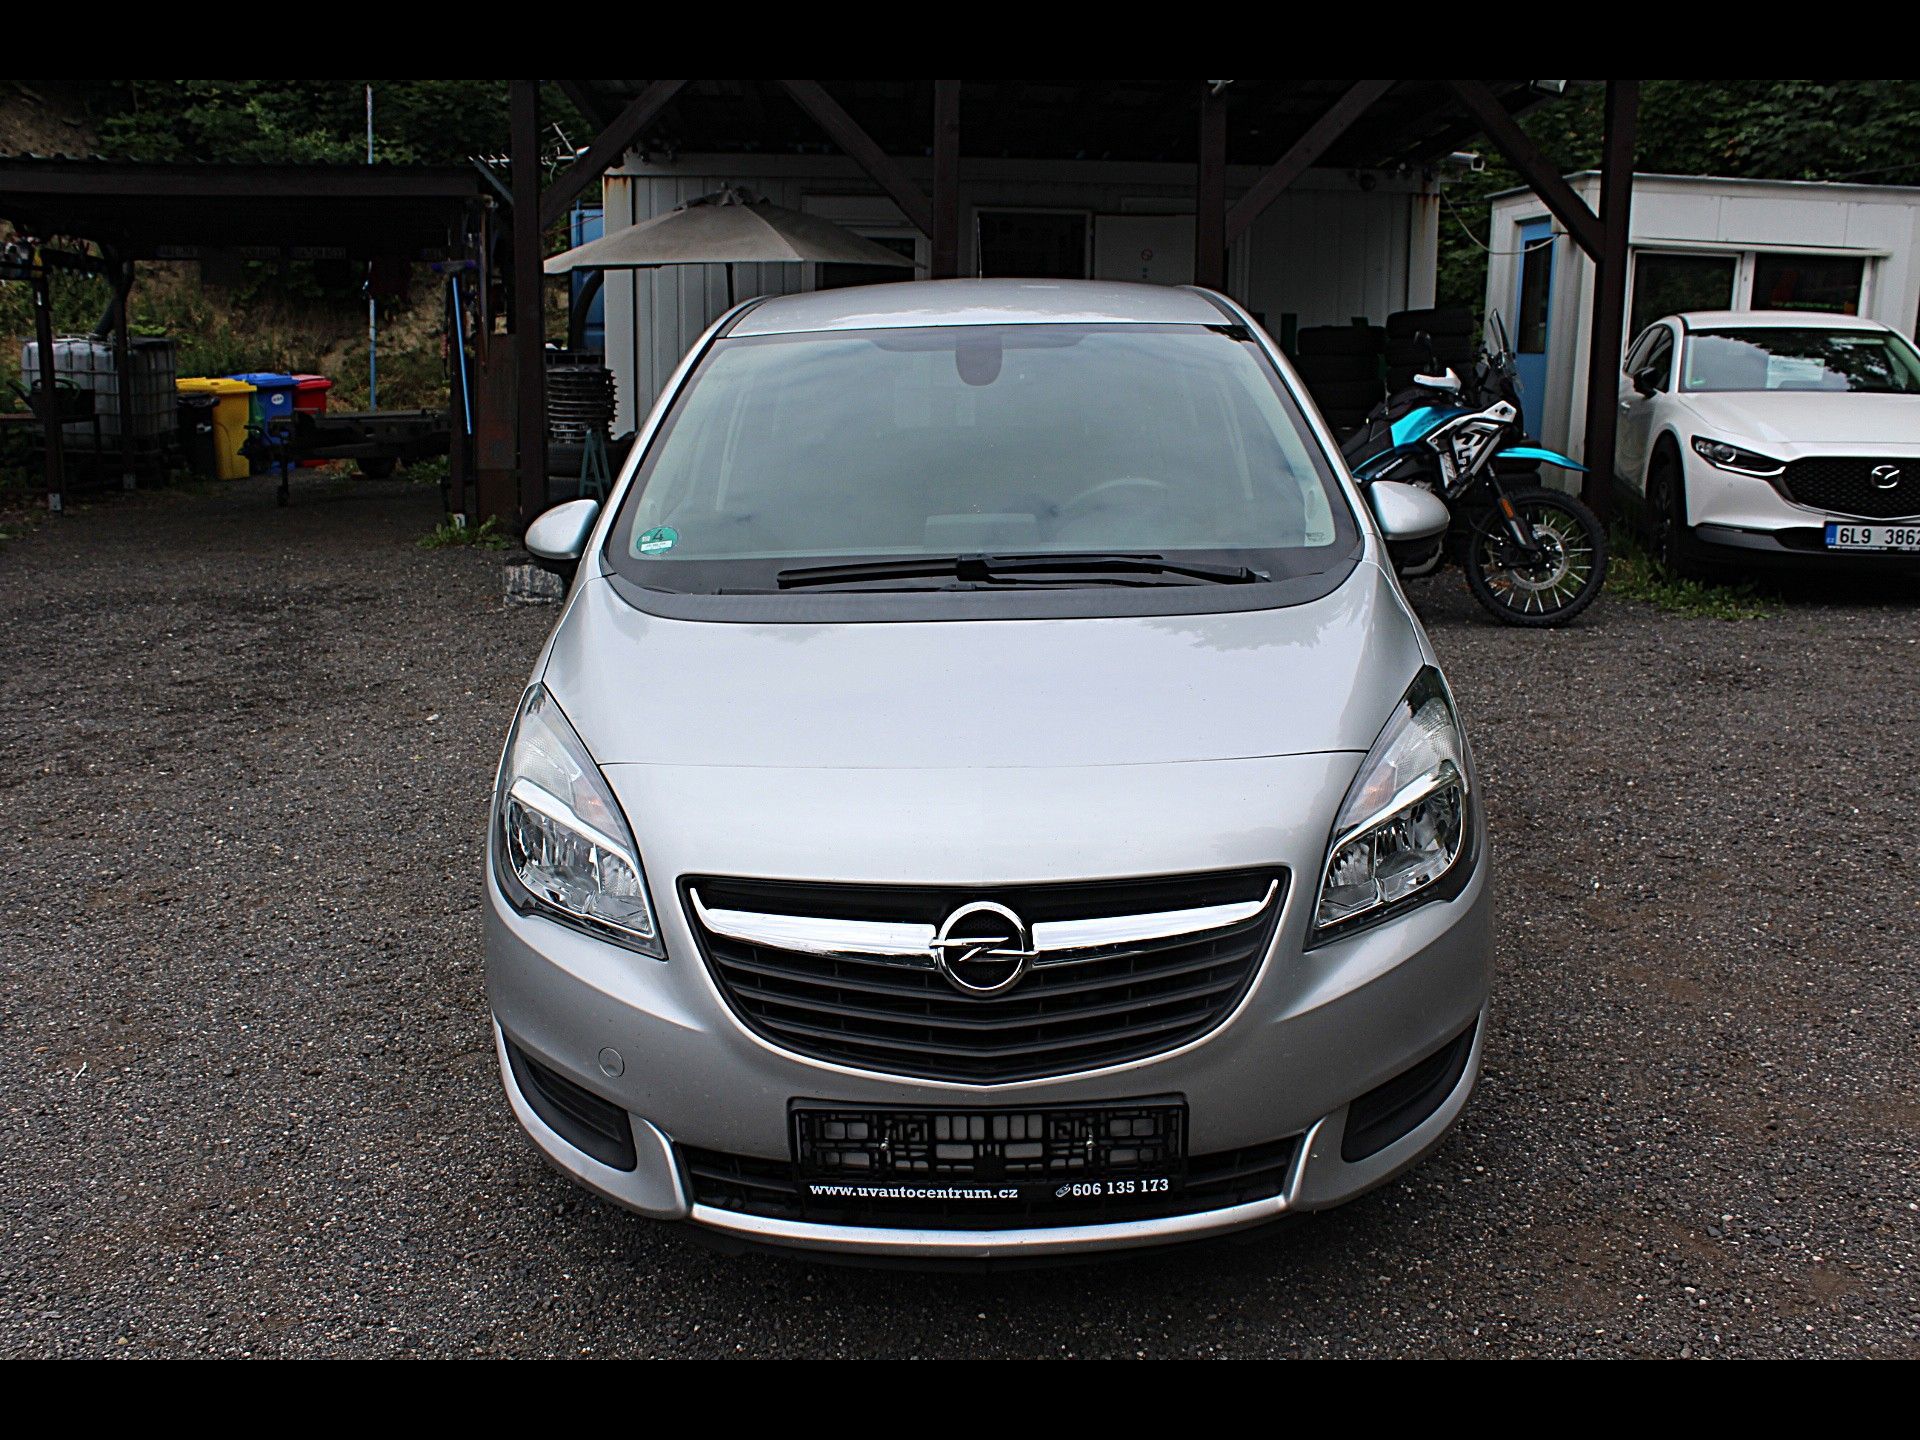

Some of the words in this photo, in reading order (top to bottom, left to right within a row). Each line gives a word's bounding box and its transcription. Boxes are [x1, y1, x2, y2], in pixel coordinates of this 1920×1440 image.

[652, 529, 664, 541] 4
[1840, 528, 1871, 544] 6L9
[809, 1185, 1018, 1199] www.uvautocentrum.cz
[1072, 1183, 1101, 1196] 606
[1107, 1181, 1135, 1194] 135
[1141, 1179, 1169, 1192] 173
